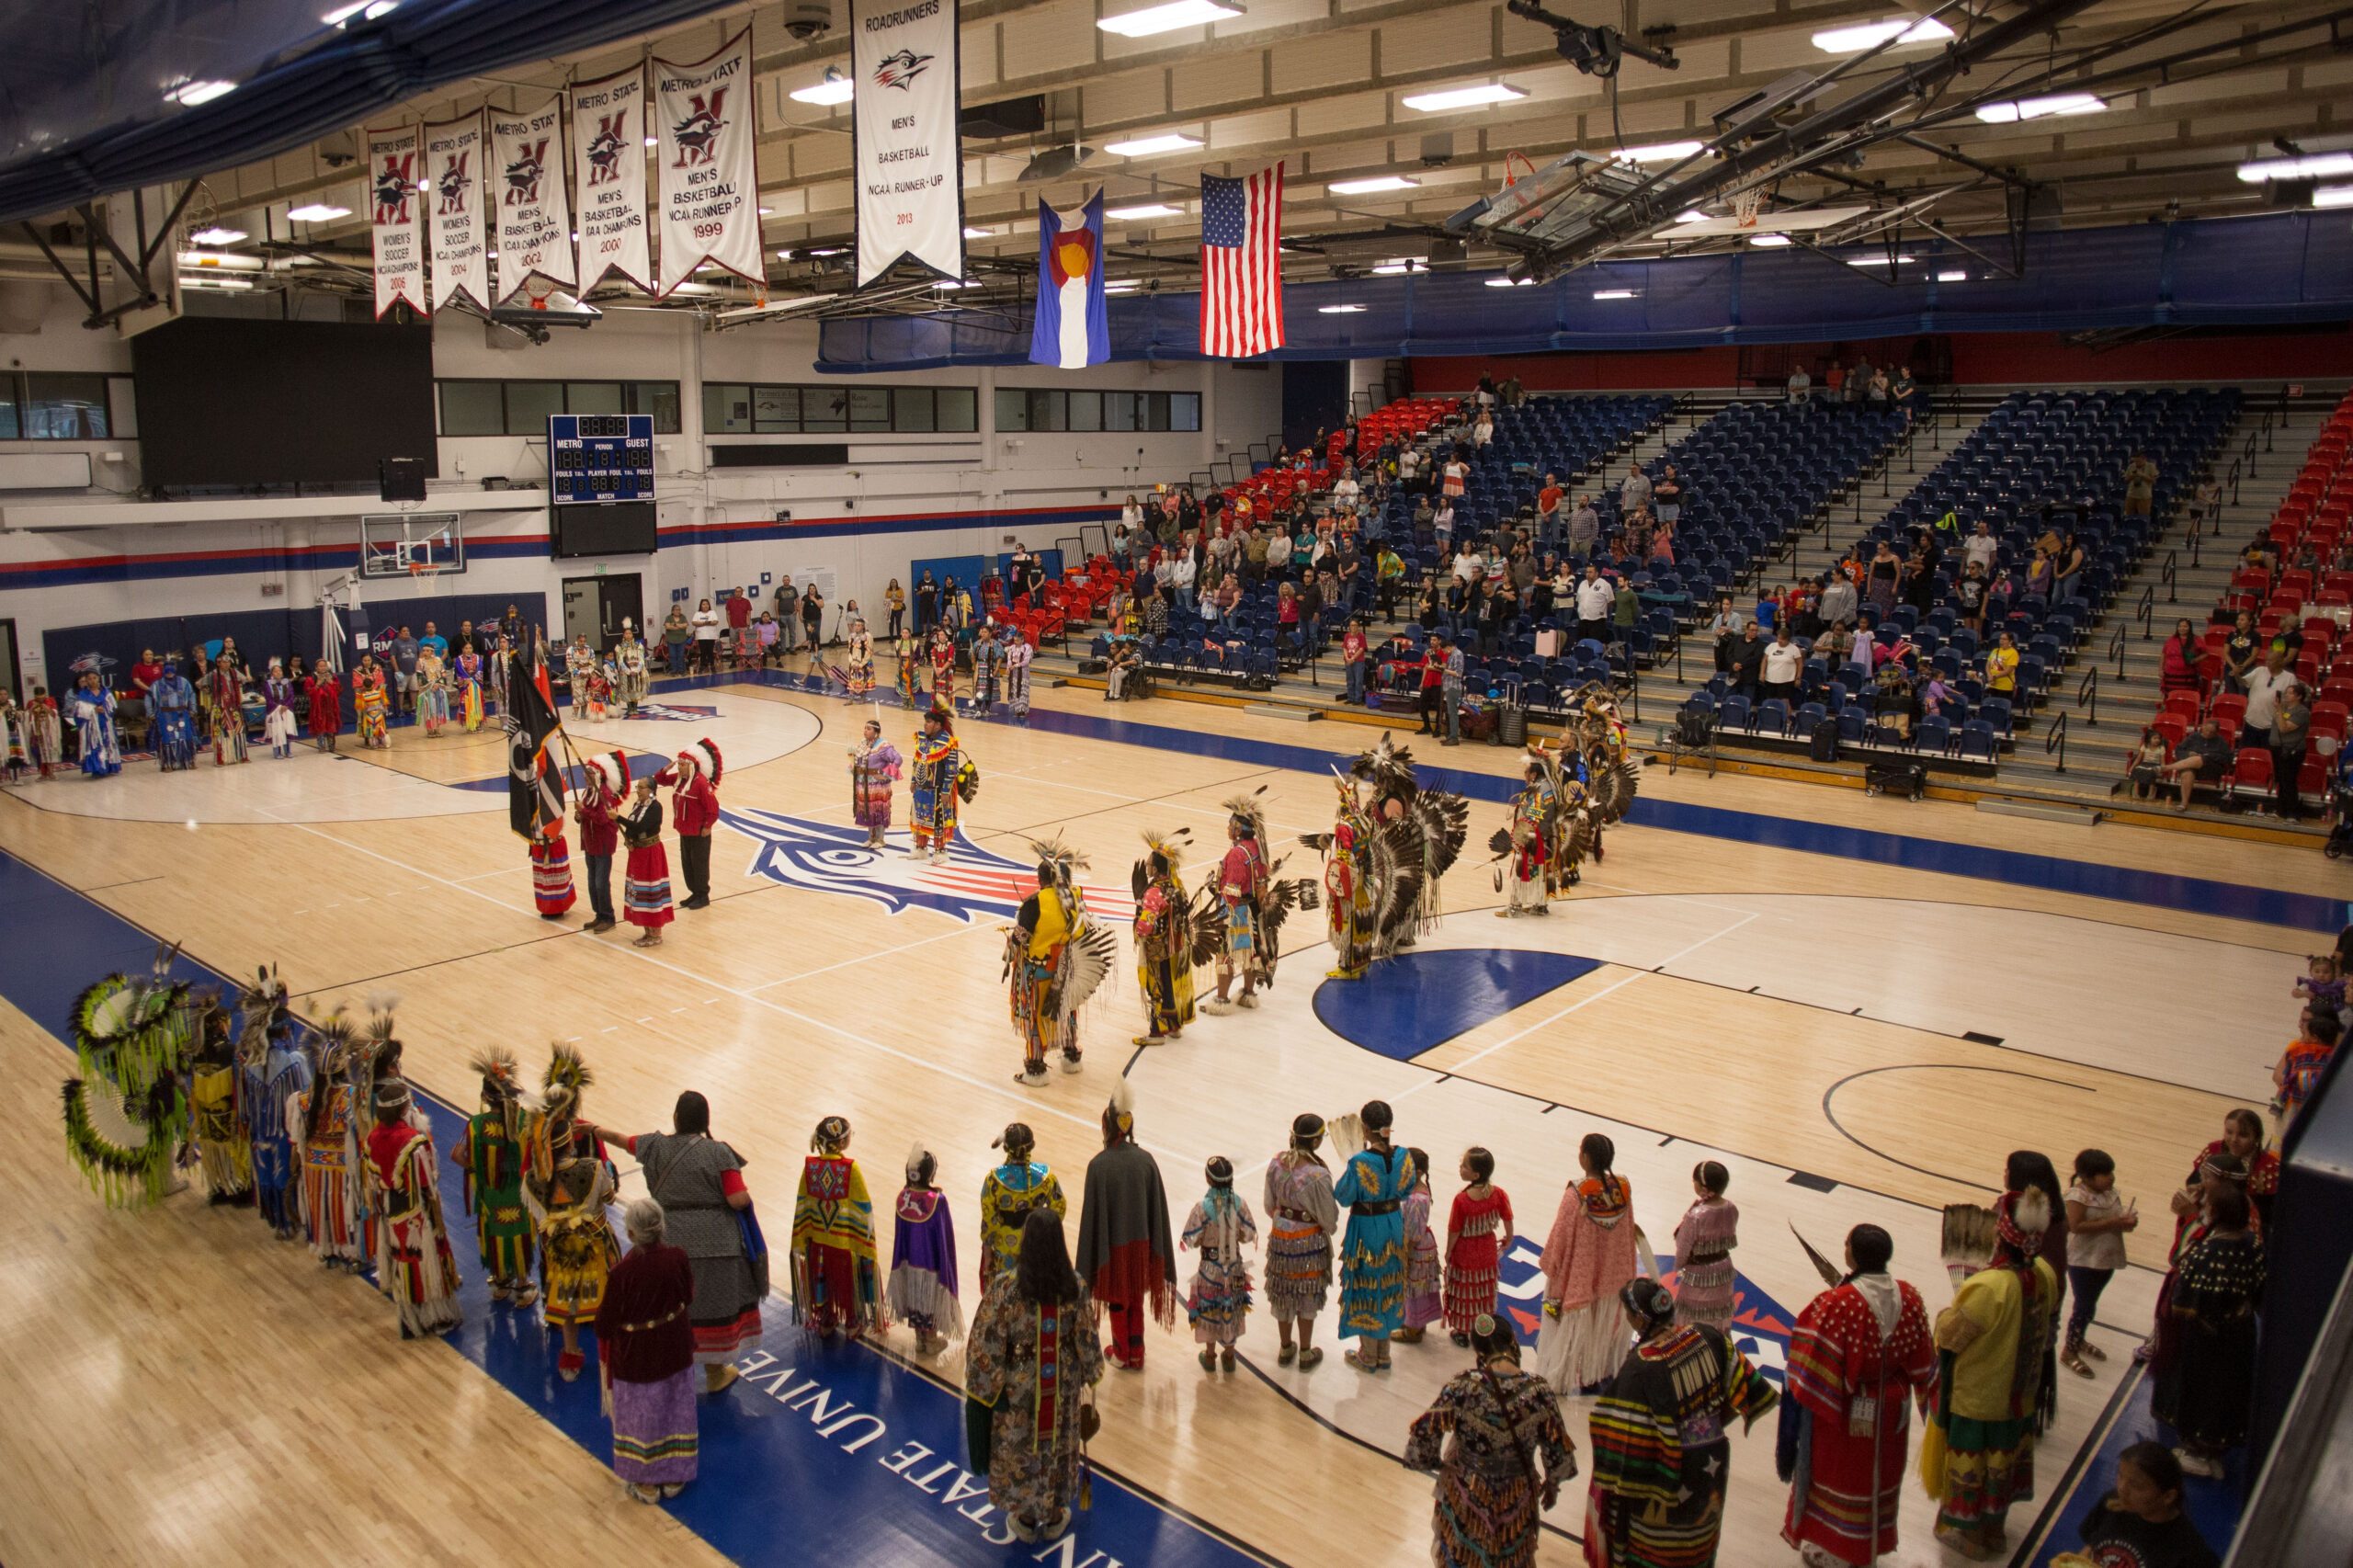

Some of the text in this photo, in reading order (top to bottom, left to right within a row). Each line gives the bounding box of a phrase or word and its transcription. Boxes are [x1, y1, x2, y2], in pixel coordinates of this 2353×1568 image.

[866, 0, 939, 33] ROADRUNNERS
[661, 78, 701, 92] METRO
[577, 78, 640, 109] METRO STATE
[494, 113, 555, 135] METRO STAT
[892, 115, 915, 130] MEN'S
[370, 135, 415, 153] METRO STATE
[429, 139, 456, 153] METRO
[879, 145, 930, 164] BASKETBALL
[688, 168, 717, 186] MEN'S
[597, 189, 622, 204] MEN'S
[674, 182, 736, 204] BSKETBAL
[868, 184, 891, 196] NCAA
[585, 203, 632, 222] BASKETBAL
[692, 196, 741, 220] RUNNERP
[442, 215, 471, 231] WOMEN'S
[505, 216, 556, 236] BSKETBL
[603, 214, 642, 235] CHAMPONS
[897, 212, 913, 225] 2013
[693, 222, 722, 238] 1999
[382, 233, 411, 246] WOMEN'S
[445, 232, 470, 245] SOCCER
[505, 228, 561, 251] CAA CHAMIONS
[600, 237, 621, 253] 2000
[384, 248, 409, 261] SOCCER
[450, 264, 467, 276] 2004
[390, 278, 405, 290] 2006
[557, 439, 583, 449] METRO
[626, 438, 649, 448] GUEST
[738, 1349, 886, 1455] UNIVE
